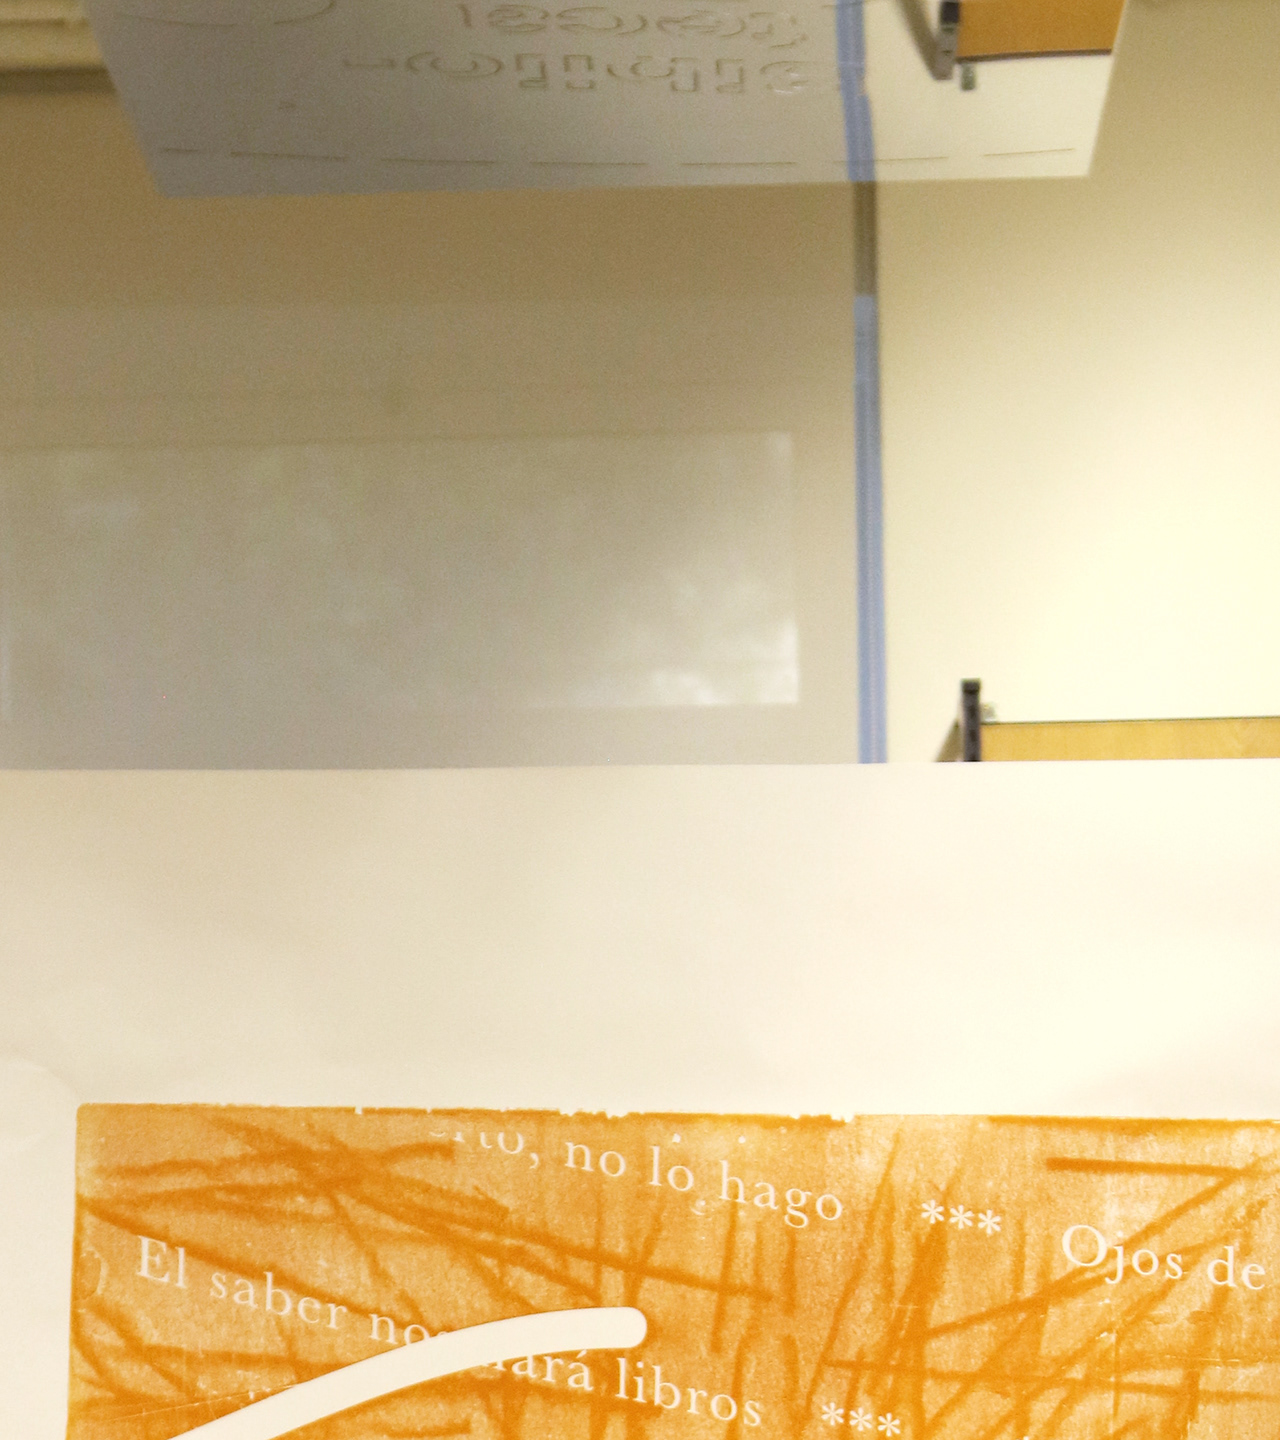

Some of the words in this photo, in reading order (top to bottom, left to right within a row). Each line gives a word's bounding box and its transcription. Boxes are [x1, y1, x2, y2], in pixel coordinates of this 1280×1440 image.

[565, 1141, 626, 1177] no
[649, 1146, 694, 1192] lo
[719, 1160, 843, 1228] hago
[1061, 1224, 1183, 1284] Ojos
[1206, 1246, 1265, 1290] de
[136, 1235, 186, 1288] El
[209, 1272, 347, 1329] saber
[370, 1314, 449, 1345] no
[615, 1358, 762, 1426] libros
